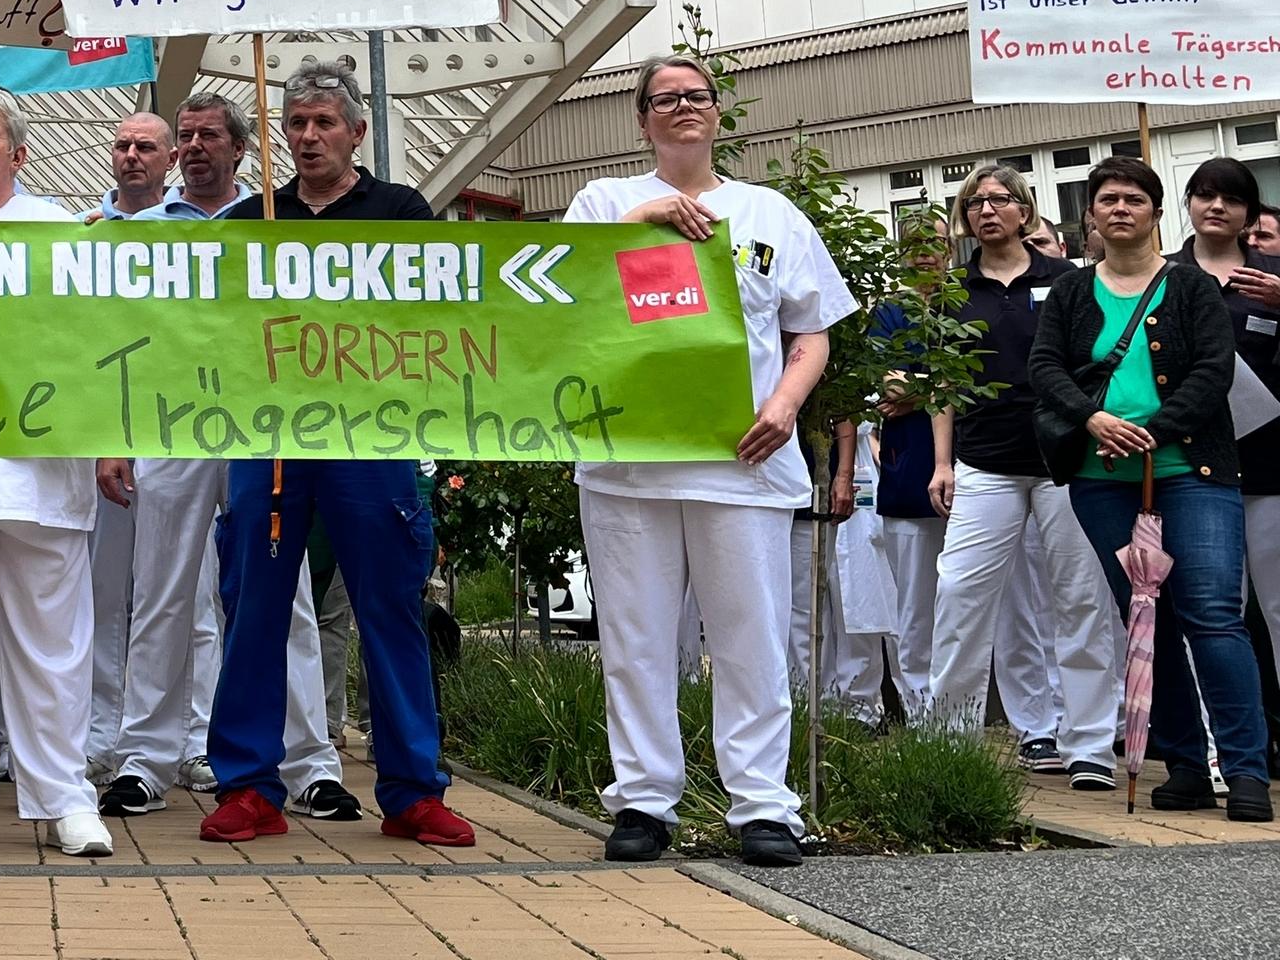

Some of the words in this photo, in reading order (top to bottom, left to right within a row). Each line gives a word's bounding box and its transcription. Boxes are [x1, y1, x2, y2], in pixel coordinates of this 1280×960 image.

[981, 29, 1151, 60] Kommunale
[1106, 65, 1251, 91] erhalten
[51, 242, 224, 301] NICHT
[247, 241, 484, 303] LOCKER!
[630, 287, 700, 307] ver.di
[263, 315, 497, 383] FORDERN
[96, 335, 624, 460] Trägerschaft
